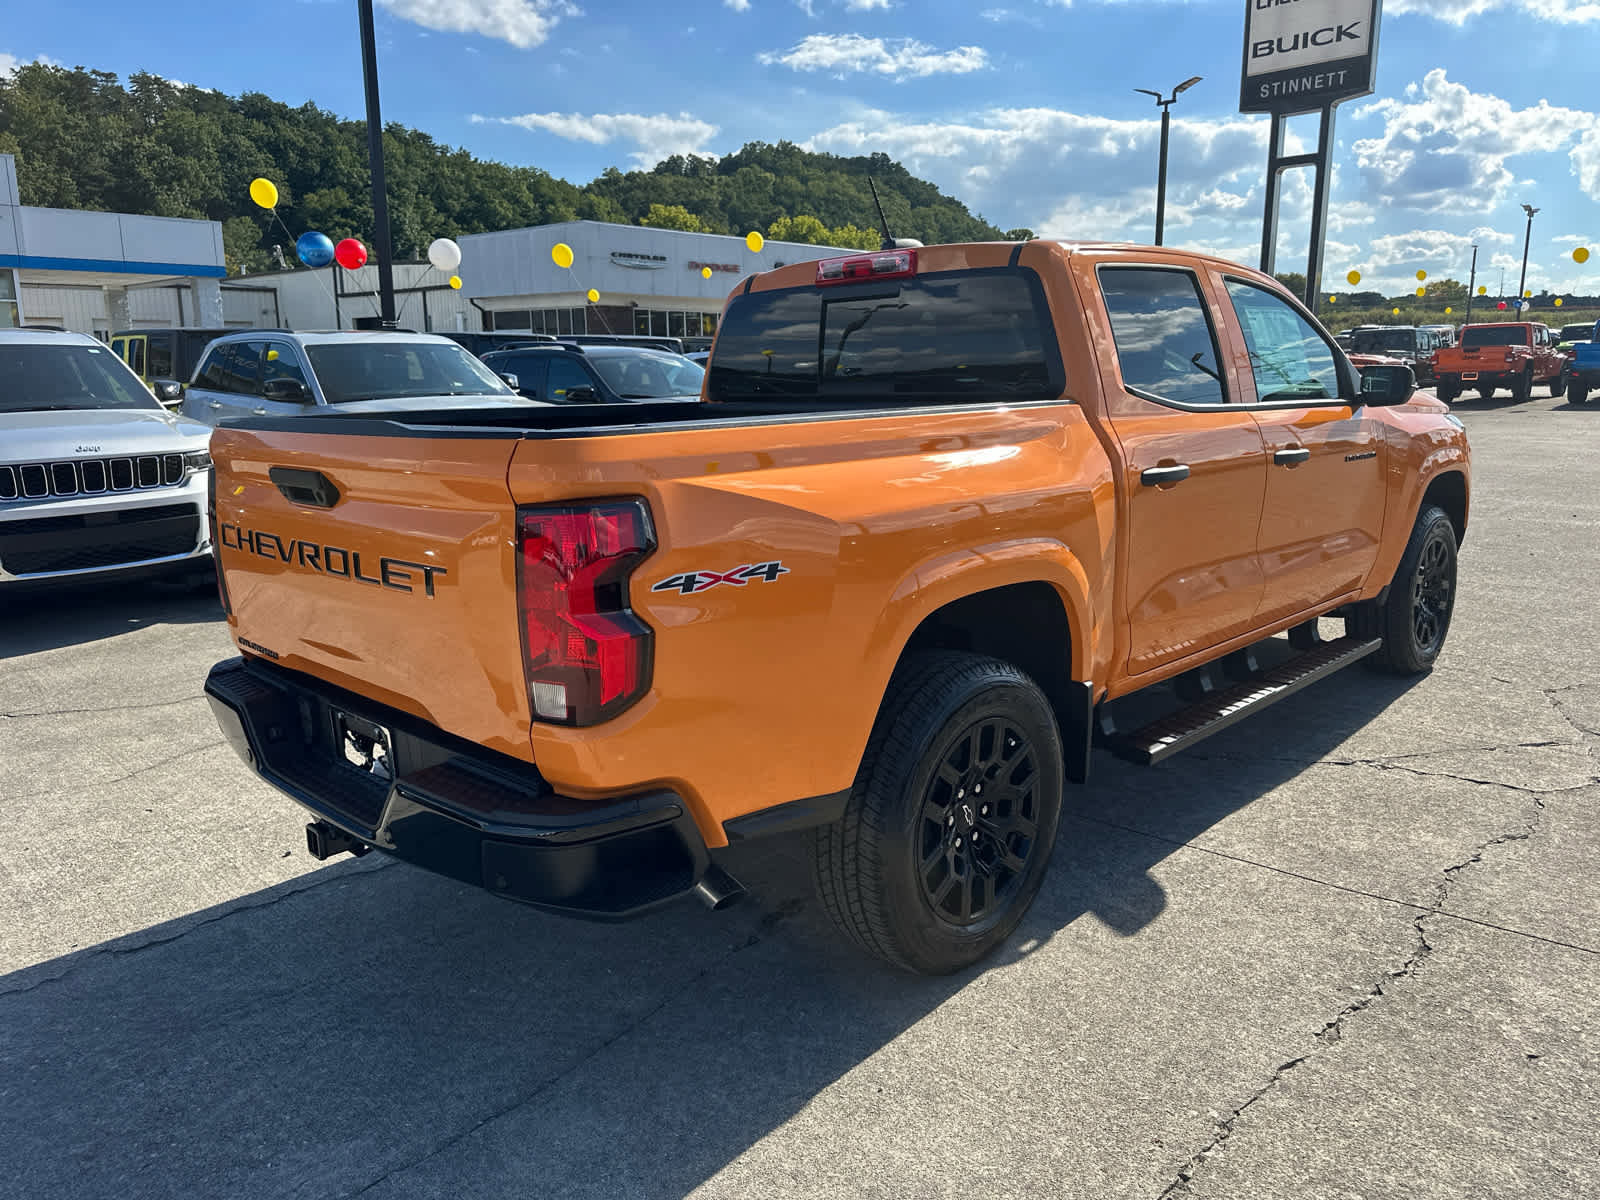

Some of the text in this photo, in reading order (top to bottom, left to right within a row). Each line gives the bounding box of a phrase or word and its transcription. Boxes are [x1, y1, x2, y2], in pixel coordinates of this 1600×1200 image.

[1252, 20, 1362, 59] BUICK
[1260, 70, 1348, 98] STINNETT
[221, 522, 448, 598] CHEVROLET
